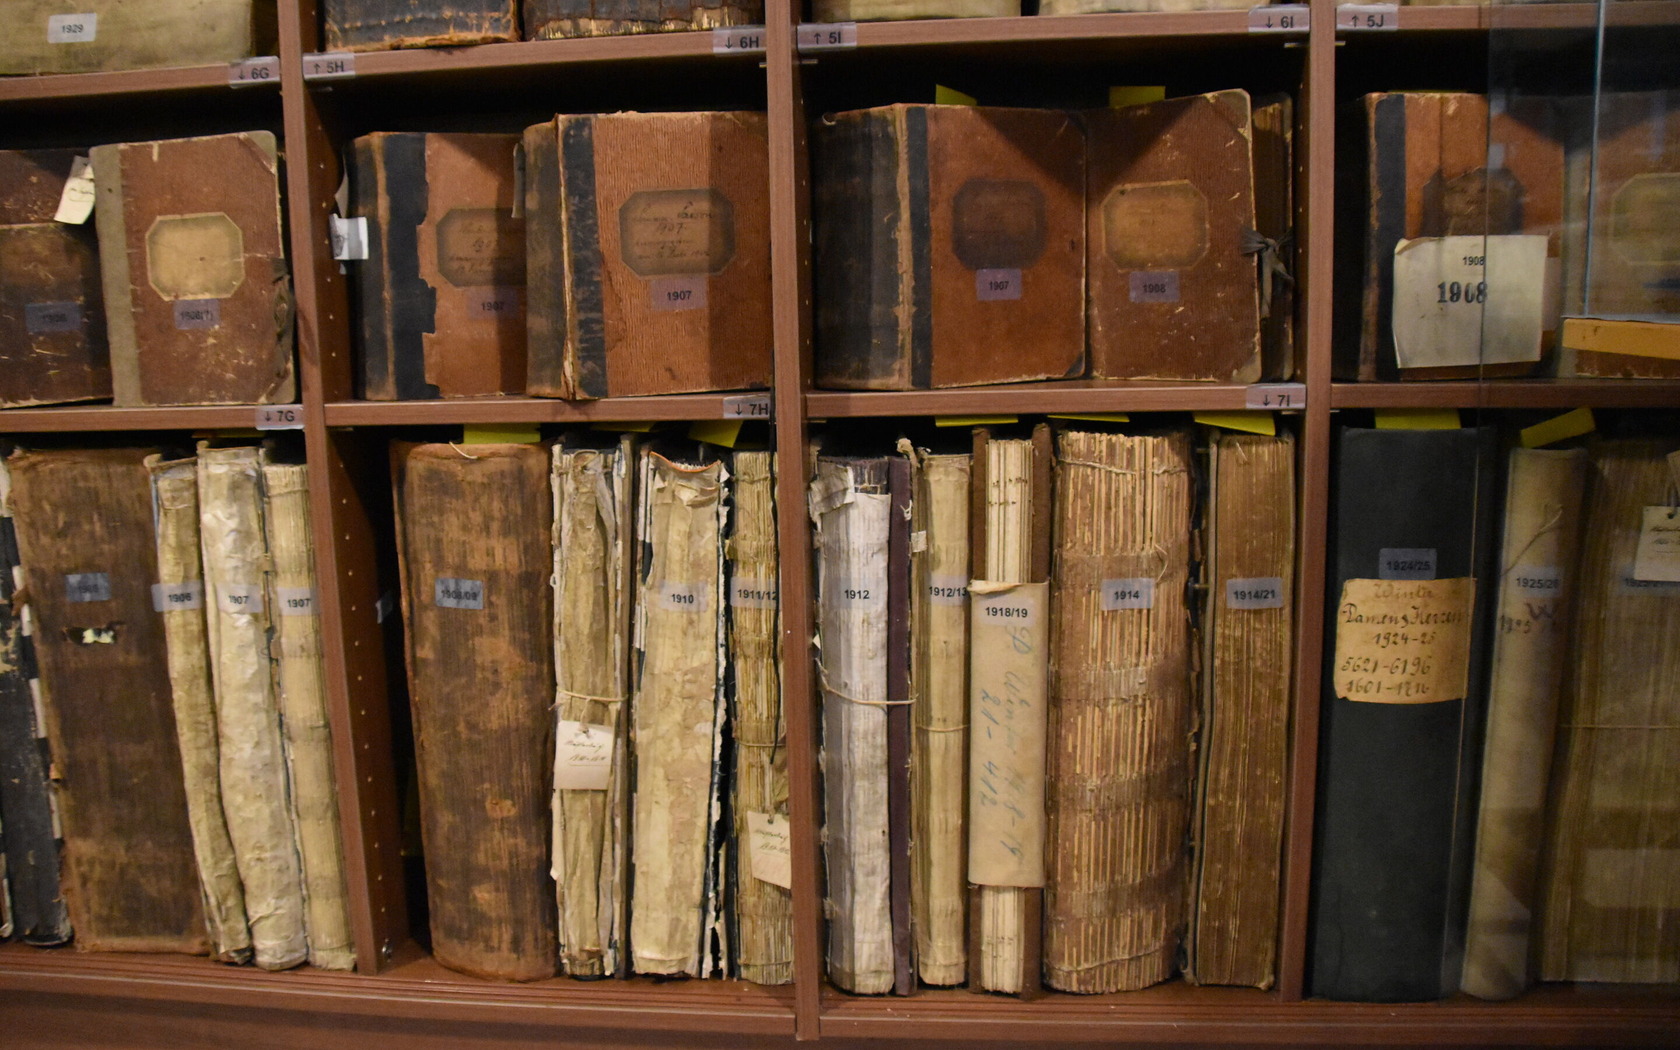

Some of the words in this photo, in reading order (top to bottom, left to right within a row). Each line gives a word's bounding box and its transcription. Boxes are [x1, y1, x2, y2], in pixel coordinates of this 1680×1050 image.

[1280, 16, 1294, 28] 6I
[1367, 15, 1385, 28] 5J
[740, 36, 760, 49] 6H
[829, 32, 843, 45] 5I
[251, 67, 270, 80] 6G
[327, 61, 345, 74] 5H
[1463, 256, 1486, 266] 1908
[988, 281, 1010, 291] 1907
[1437, 281, 1488, 304] 1908
[667, 290, 693, 302] 1907
[1278, 394, 1291, 407] 7I
[749, 403, 770, 416] 7H
[278, 410, 296, 423] 7G
[1386, 560, 1432, 573] 1924/25
[169, 592, 193, 604] 1906
[737, 588, 779, 601] 1911/12
[844, 588, 871, 601] 1912
[929, 585, 970, 599] 1912/13
[1114, 589, 1141, 601] 1914
[1233, 589, 1277, 602] 1914/21
[287, 598, 312, 609] 1907
[671, 593, 695, 605] 1910
[985, 605, 1029, 619] 1918/19
